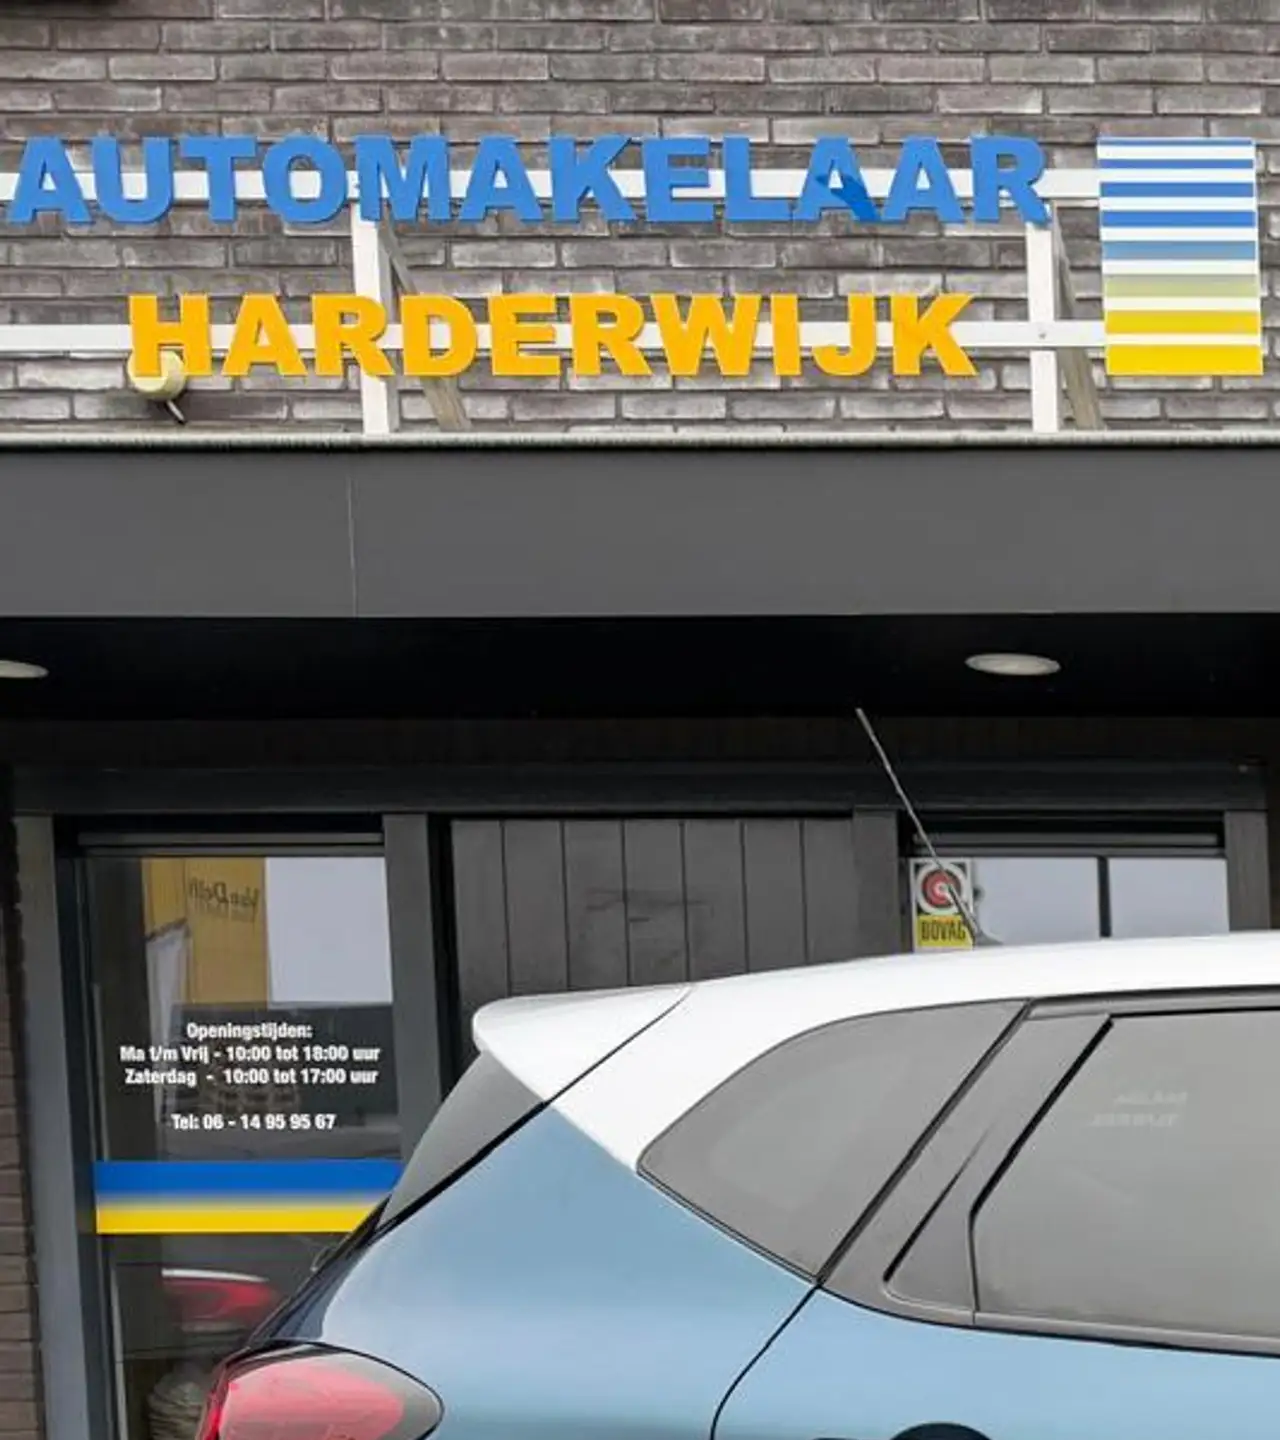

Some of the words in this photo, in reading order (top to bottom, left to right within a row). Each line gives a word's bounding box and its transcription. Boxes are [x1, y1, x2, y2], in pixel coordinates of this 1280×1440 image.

[8, 134, 1049, 225] AUTOMAKELAAR
[127, 291, 979, 378] HARDERWIJK
[186, 1022, 313, 1041] Openingstijden:
[120, 1046, 145, 1061] Ma
[149, 1046, 178, 1061] t/m
[180, 1046, 210, 1064] Vrij
[226, 1046, 271, 1061] 10:00
[275, 1046, 298, 1061] tot
[303, 1046, 349, 1061] 18:00
[353, 1048, 380, 1061] uur
[125, 1068, 197, 1087] Zaterdag
[223, 1068, 269, 1084] 10:00
[273, 1068, 296, 1084] tot
[301, 1068, 346, 1084] 17:00
[350, 1070, 379, 1084] uur
[170, 1114, 199, 1130] Tel:
[203, 1114, 224, 1130] 06
[240, 1114, 260, 1130] 14
[265, 1114, 286, 1130] 95
[290, 1114, 311, 1130] 95
[315, 1114, 336, 1130] 67
